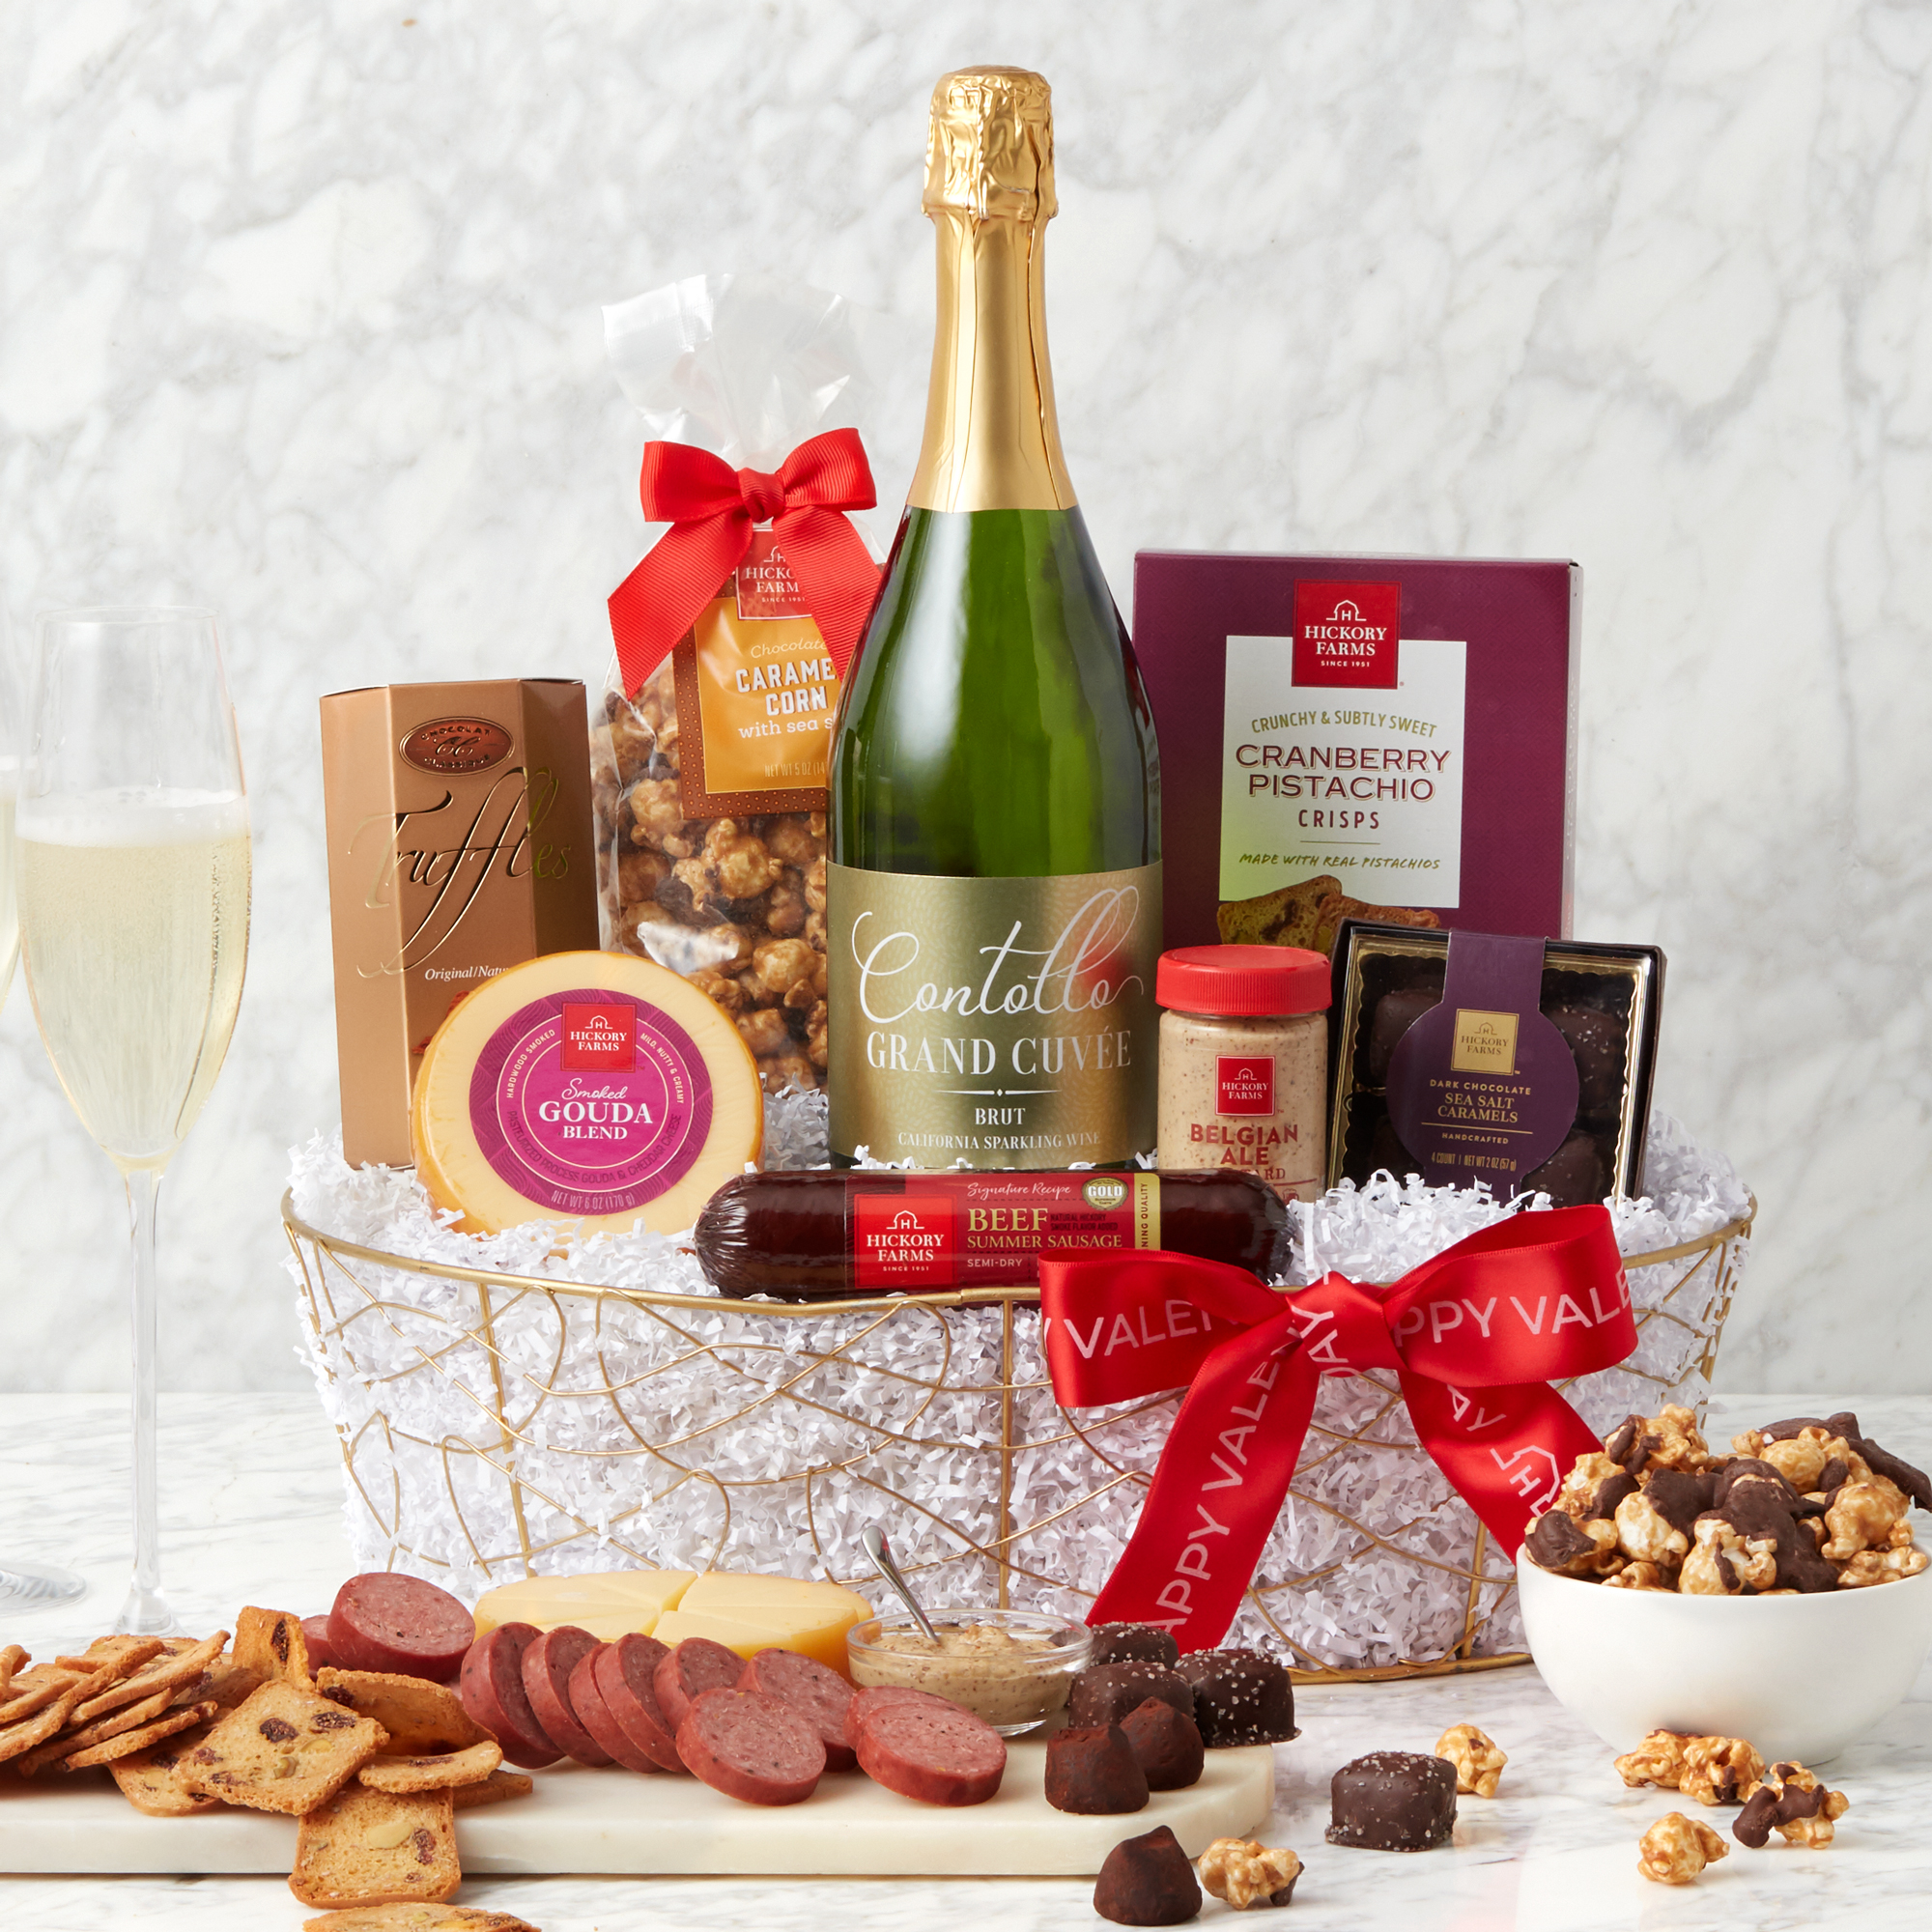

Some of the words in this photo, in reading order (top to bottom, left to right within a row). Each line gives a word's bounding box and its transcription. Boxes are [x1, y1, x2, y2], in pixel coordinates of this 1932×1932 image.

[1342, 611, 1351, 621] H
[1304, 626, 1387, 640] HICKORY
[1316, 642, 1376, 656] FARMS
[735, 658, 837, 693] CARAME
[765, 686, 828, 716] CORN
[738, 720, 781, 739] with
[786, 719, 818, 734] sea
[1251, 711, 1317, 733] CRUNCHY
[1321, 711, 1330, 724] &
[1334, 710, 1386, 727] SUBTLY
[1388, 716, 1437, 738] SWEET
[1236, 744, 1452, 773] CRANBERRY
[764, 763, 779, 777] NET
[781, 762, 792, 777] WT
[794, 763, 800, 776] 5
[801, 762, 811, 776] OZ
[1249, 774, 1435, 803] PISTACHIO
[1298, 810, 1379, 829] CRISPS
[1239, 853, 1278, 865] MADE
[1283, 855, 1319, 867] WITH
[1323, 856, 1358, 867] REAL
[1361, 857, 1440, 869] PISTACHIOS
[348, 766, 571, 978] Truffles
[570, 1032, 627, 1042] HICKORY
[1461, 1035, 1509, 1047] HICKORY
[578, 1041, 620, 1051] FARMS
[867, 1031, 996, 1075] GRAND
[1011, 1025, 1132, 1075] CUVÉE
[1466, 1045, 1502, 1056] FARMS
[506, 1054, 527, 1098] HARDWOOD
[526, 1029, 555, 1054] SMOKED
[657, 1046, 674, 1066] NUTTY
[673, 1075, 684, 1104] CREAMY
[561, 1078, 628, 1100] Smoked
[1222, 1082, 1268, 1091] HICKORY
[1430, 1079, 1460, 1089] DARK
[1463, 1082, 1531, 1095] CHOCOLATE
[1444, 1093, 1473, 1106] SEA
[1477, 1094, 1515, 1109] SALT
[538, 1101, 653, 1123] GOUDA
[975, 1108, 1026, 1125] BRUT
[1437, 1105, 1519, 1123] CARAMELS
[562, 1125, 628, 1140] BLEND
[897, 1132, 980, 1150] CALIFORNIA
[983, 1135, 1062, 1150] SPARKLING
[1065, 1131, 1101, 1146] WINE
[1190, 1123, 1298, 1146] BELGIAN
[1441, 1132, 1509, 1145] HANDCRAFTED
[507, 1110, 542, 1162] PASTEURIZED
[540, 1157, 580, 1181] PROCESS
[582, 1173, 616, 1184] GOUDA
[617, 1169, 627, 1180] &
[627, 1144, 666, 1176] CHEDDAR
[661, 1113, 682, 1147] CHEESE
[1220, 1147, 1269, 1166] ALE
[1436, 1152, 1456, 1165] COUNT
[1463, 1154, 1475, 1167] NET
[1476, 1155, 1485, 1167] WT
[1491, 1157, 1499, 1169] OZ
[551, 1189, 568, 1206] NET
[569, 1194, 582, 1208] WT
[583, 1195, 590, 1209] 6
[592, 1196, 603, 1210] OZ
[605, 1193, 625, 1210] (170
[625, 1191, 636, 1208] g)
[967, 1182, 1029, 1201] Signature
[1032, 1182, 1072, 1201] Recipe
[1088, 1185, 1123, 1197] GOLD
[900, 1219, 910, 1230] H
[967, 1208, 1049, 1232] BEEF
[1050, 1213, 1078, 1222] NATURAL
[1079, 1213, 1106, 1222] HICKORY
[1050, 1222, 1071, 1232] SMOKE
[1072, 1222, 1095, 1231] FLAVOR
[1097, 1222, 1118, 1231] ADDED
[867, 1234, 945, 1247] HICKORY
[967, 1235, 1043, 1248] SUMMER
[1047, 1235, 1122, 1248] SAUSAGE
[877, 1249, 934, 1262] FARMS
[967, 1258, 1023, 1267] SEMI-DRY
